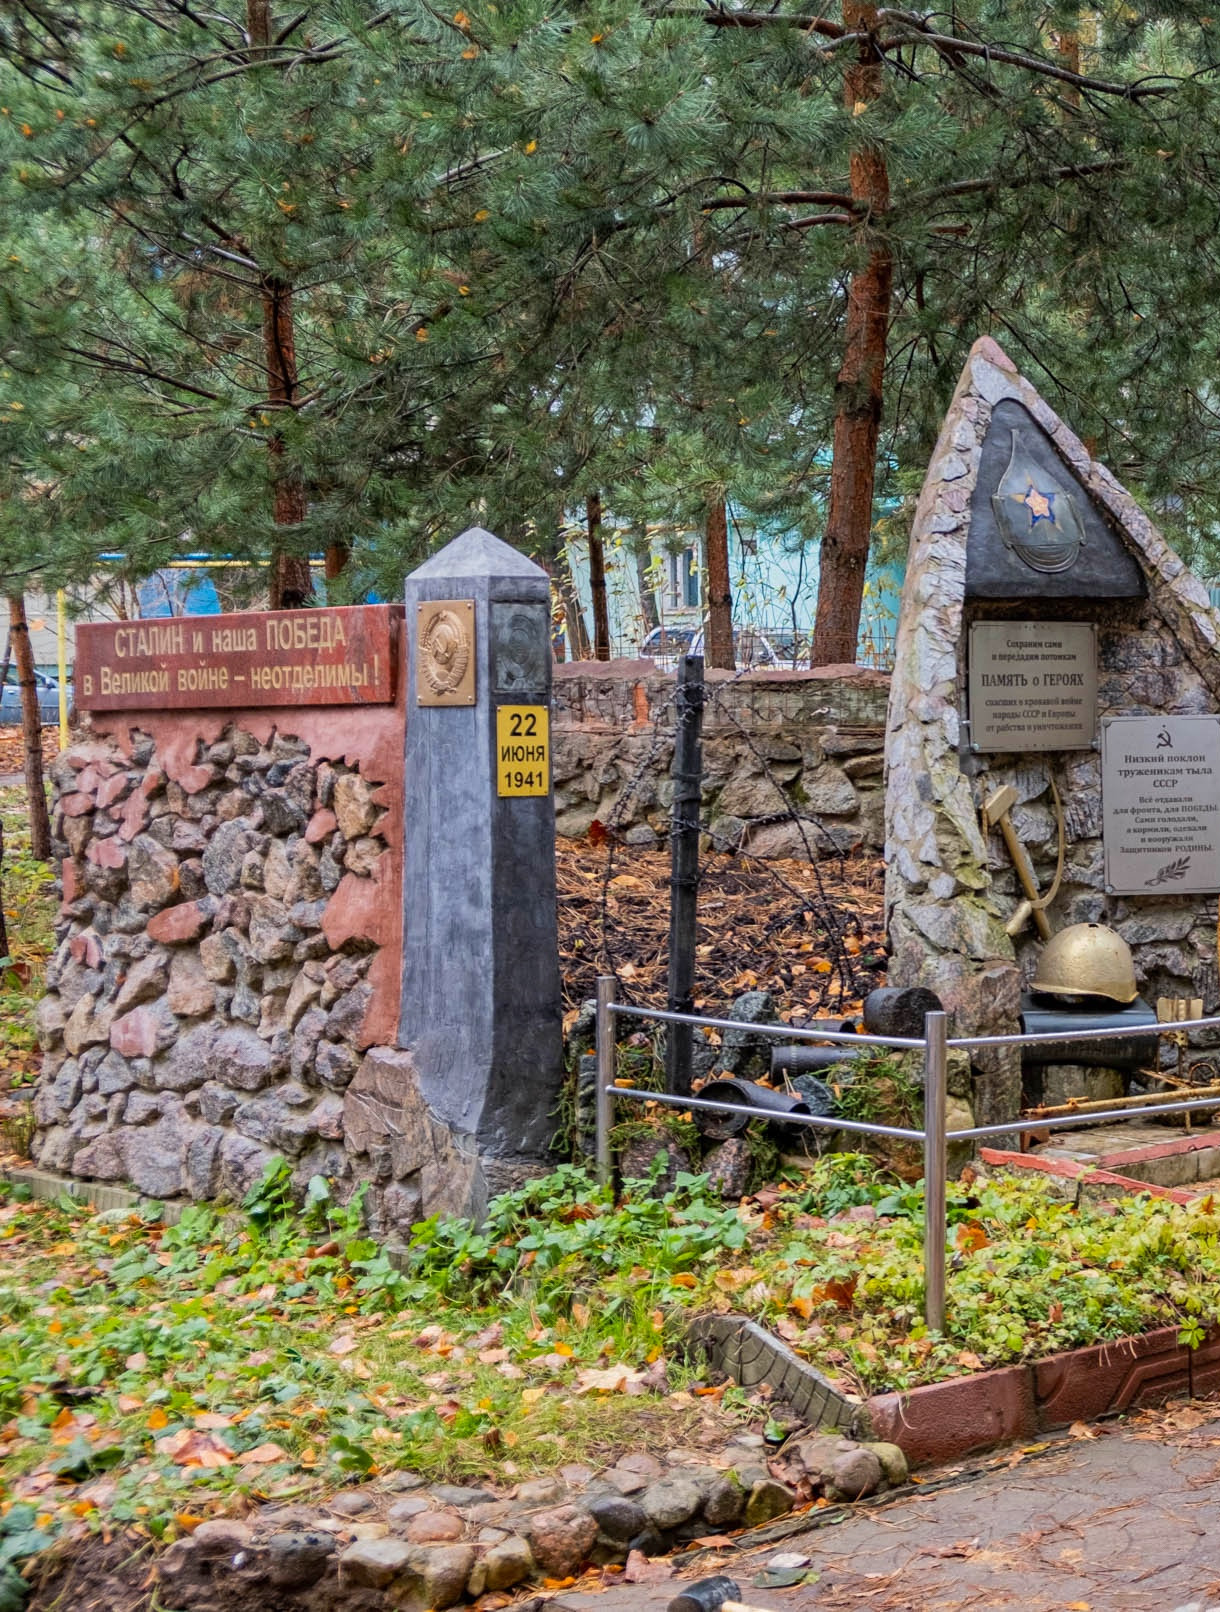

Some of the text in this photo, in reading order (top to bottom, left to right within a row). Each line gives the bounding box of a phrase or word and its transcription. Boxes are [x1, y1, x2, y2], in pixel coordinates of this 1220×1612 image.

[114, 616, 346, 657] СТАЛИН и наша ПОБЕДА
[1006, 640, 1043, 650] Сохраним
[998, 654, 1040, 663] передадим
[83, 674, 93, 696] в
[101, 662, 169, 695] Великой
[178, 660, 229, 691] войне
[982, 673, 1085, 687] ПАМЯТЬ о ГЕРОЯХ
[992, 711, 1021, 720] народы
[1022, 709, 1041, 718] СССР
[509, 713, 538, 737] 22
[501, 745, 545, 762] ИЮНЯ
[1124, 754, 1206, 763] Низкий поклон
[1117, 767, 1213, 778] труженикам тыла
[504, 771, 543, 788] 1941
[1153, 779, 1178, 788] СССР
[1134, 816, 1156, 824] Сами
